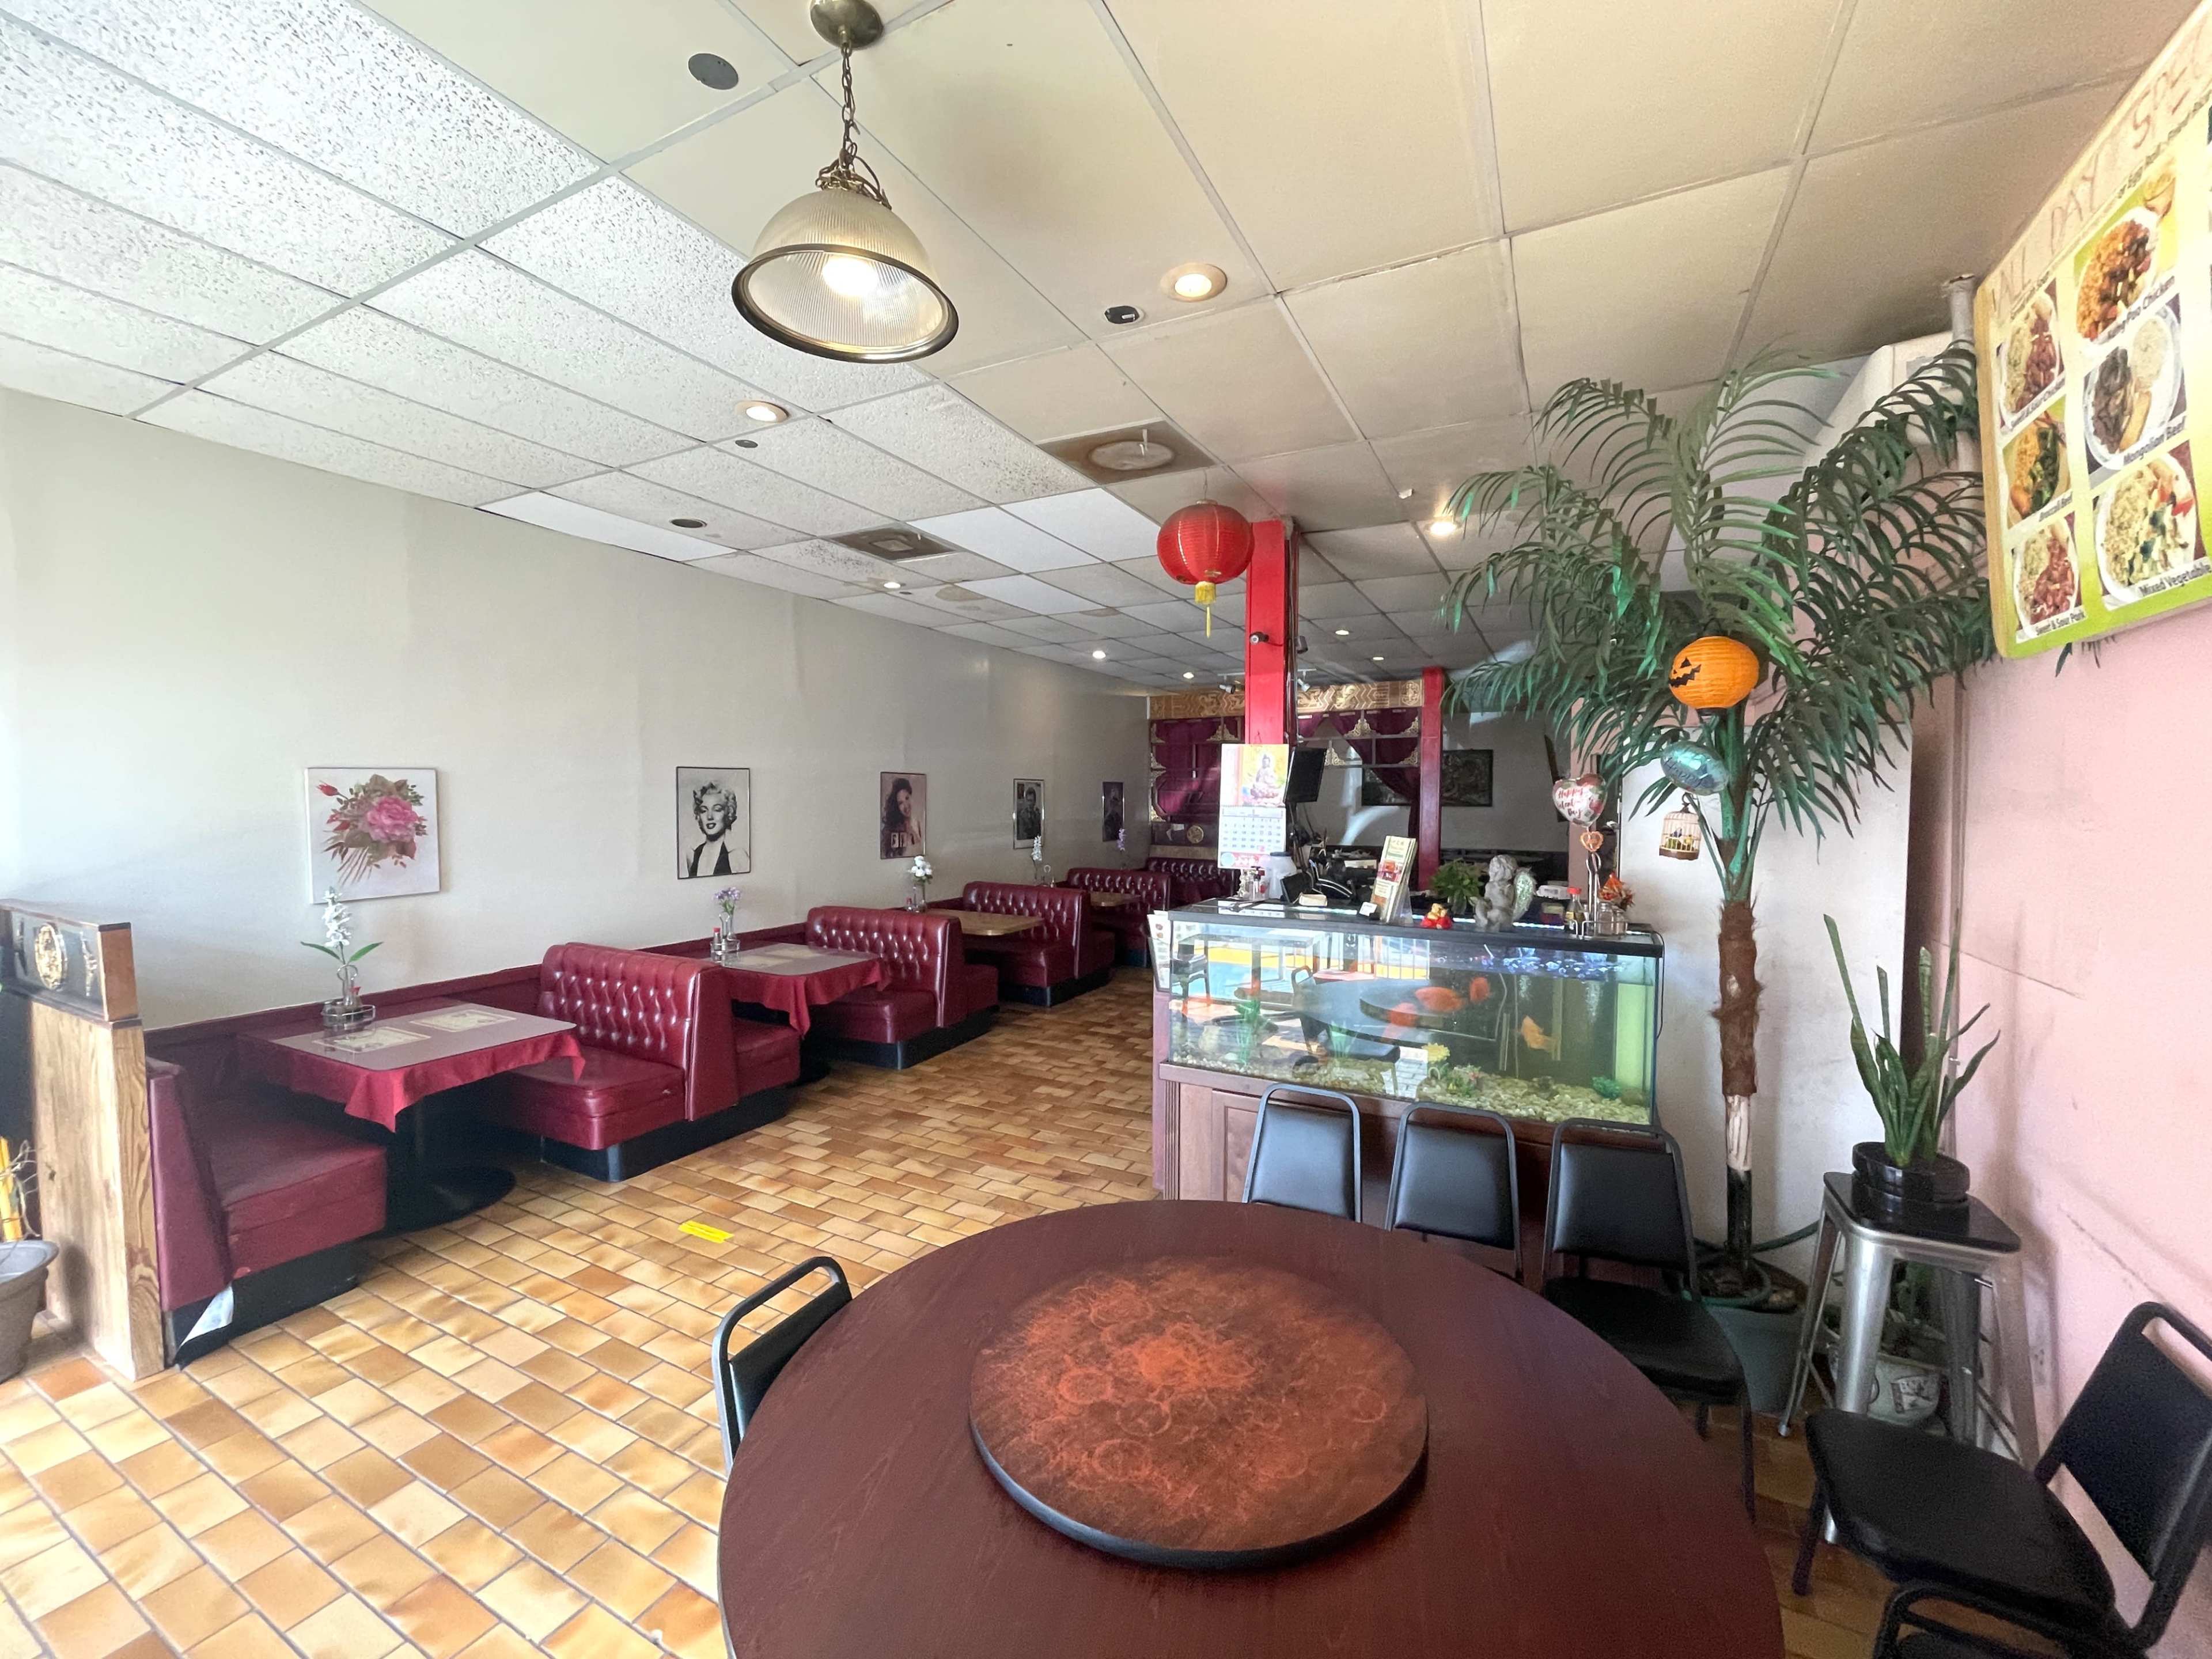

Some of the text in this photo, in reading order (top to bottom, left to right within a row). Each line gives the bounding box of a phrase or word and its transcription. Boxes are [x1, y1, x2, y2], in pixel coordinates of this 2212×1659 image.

[2123, 415, 2187, 465] Mongolian Beef
[2139, 577, 2166, 597] Mixed
[2056, 617, 2070, 628] Sour
[2070, 609, 2086, 623] Pork
[1558, 787, 1584, 799] Happy
[1567, 808, 1582, 819] Day
